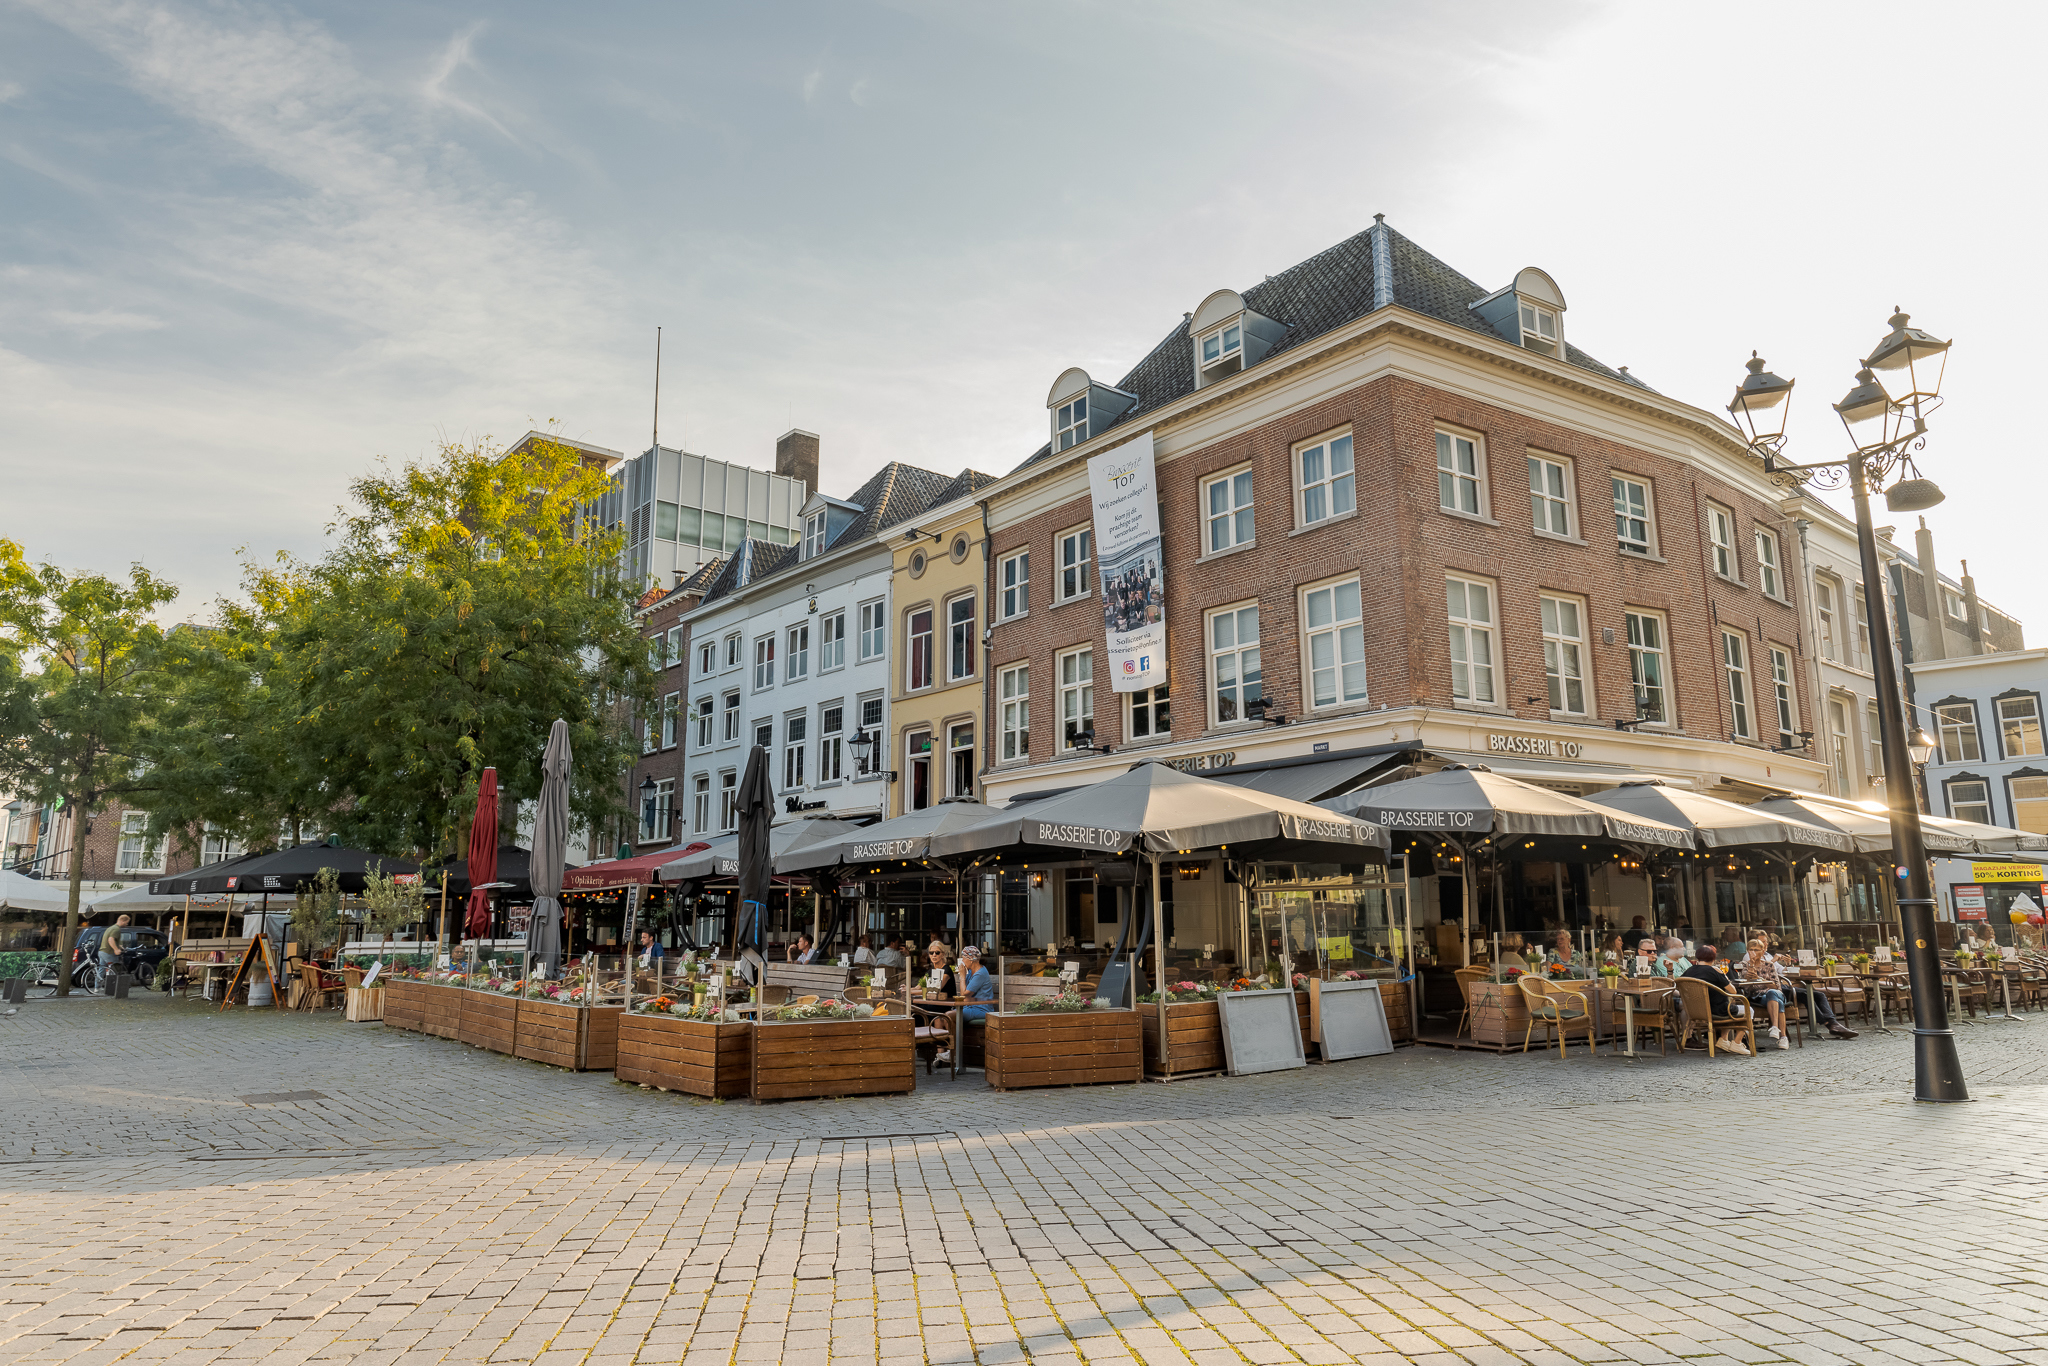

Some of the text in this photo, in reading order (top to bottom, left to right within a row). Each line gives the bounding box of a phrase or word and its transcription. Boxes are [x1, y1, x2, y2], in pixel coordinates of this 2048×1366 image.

[1112, 473, 1135, 490] TOP
[1098, 483, 1148, 510] Wij zoeken collega's!
[1114, 513, 1126, 522] Kom
[1108, 519, 1131, 535] prachtige
[1116, 630, 1151, 646] Solliciteer via
[1489, 734, 1584, 758] BRASSERIE TOP
[1206, 751, 1236, 769] TOP
[1380, 810, 1474, 827] BRASSERIE TOP
[1039, 823, 1121, 847] BRASSERIE TOP
[1297, 818, 1375, 841] BRASSERIE TOP
[1616, 821, 1683, 844] BRASSERIE TOP
[1793, 827, 1843, 847] BRASSERIE TOP
[853, 840, 914, 859] BRASSERIE TOP
[1928, 834, 1958, 848] BRASSERIE
[574, 875, 605, 888] Opkikkertje
[1974, 870, 2042, 879] 50% KORTING
